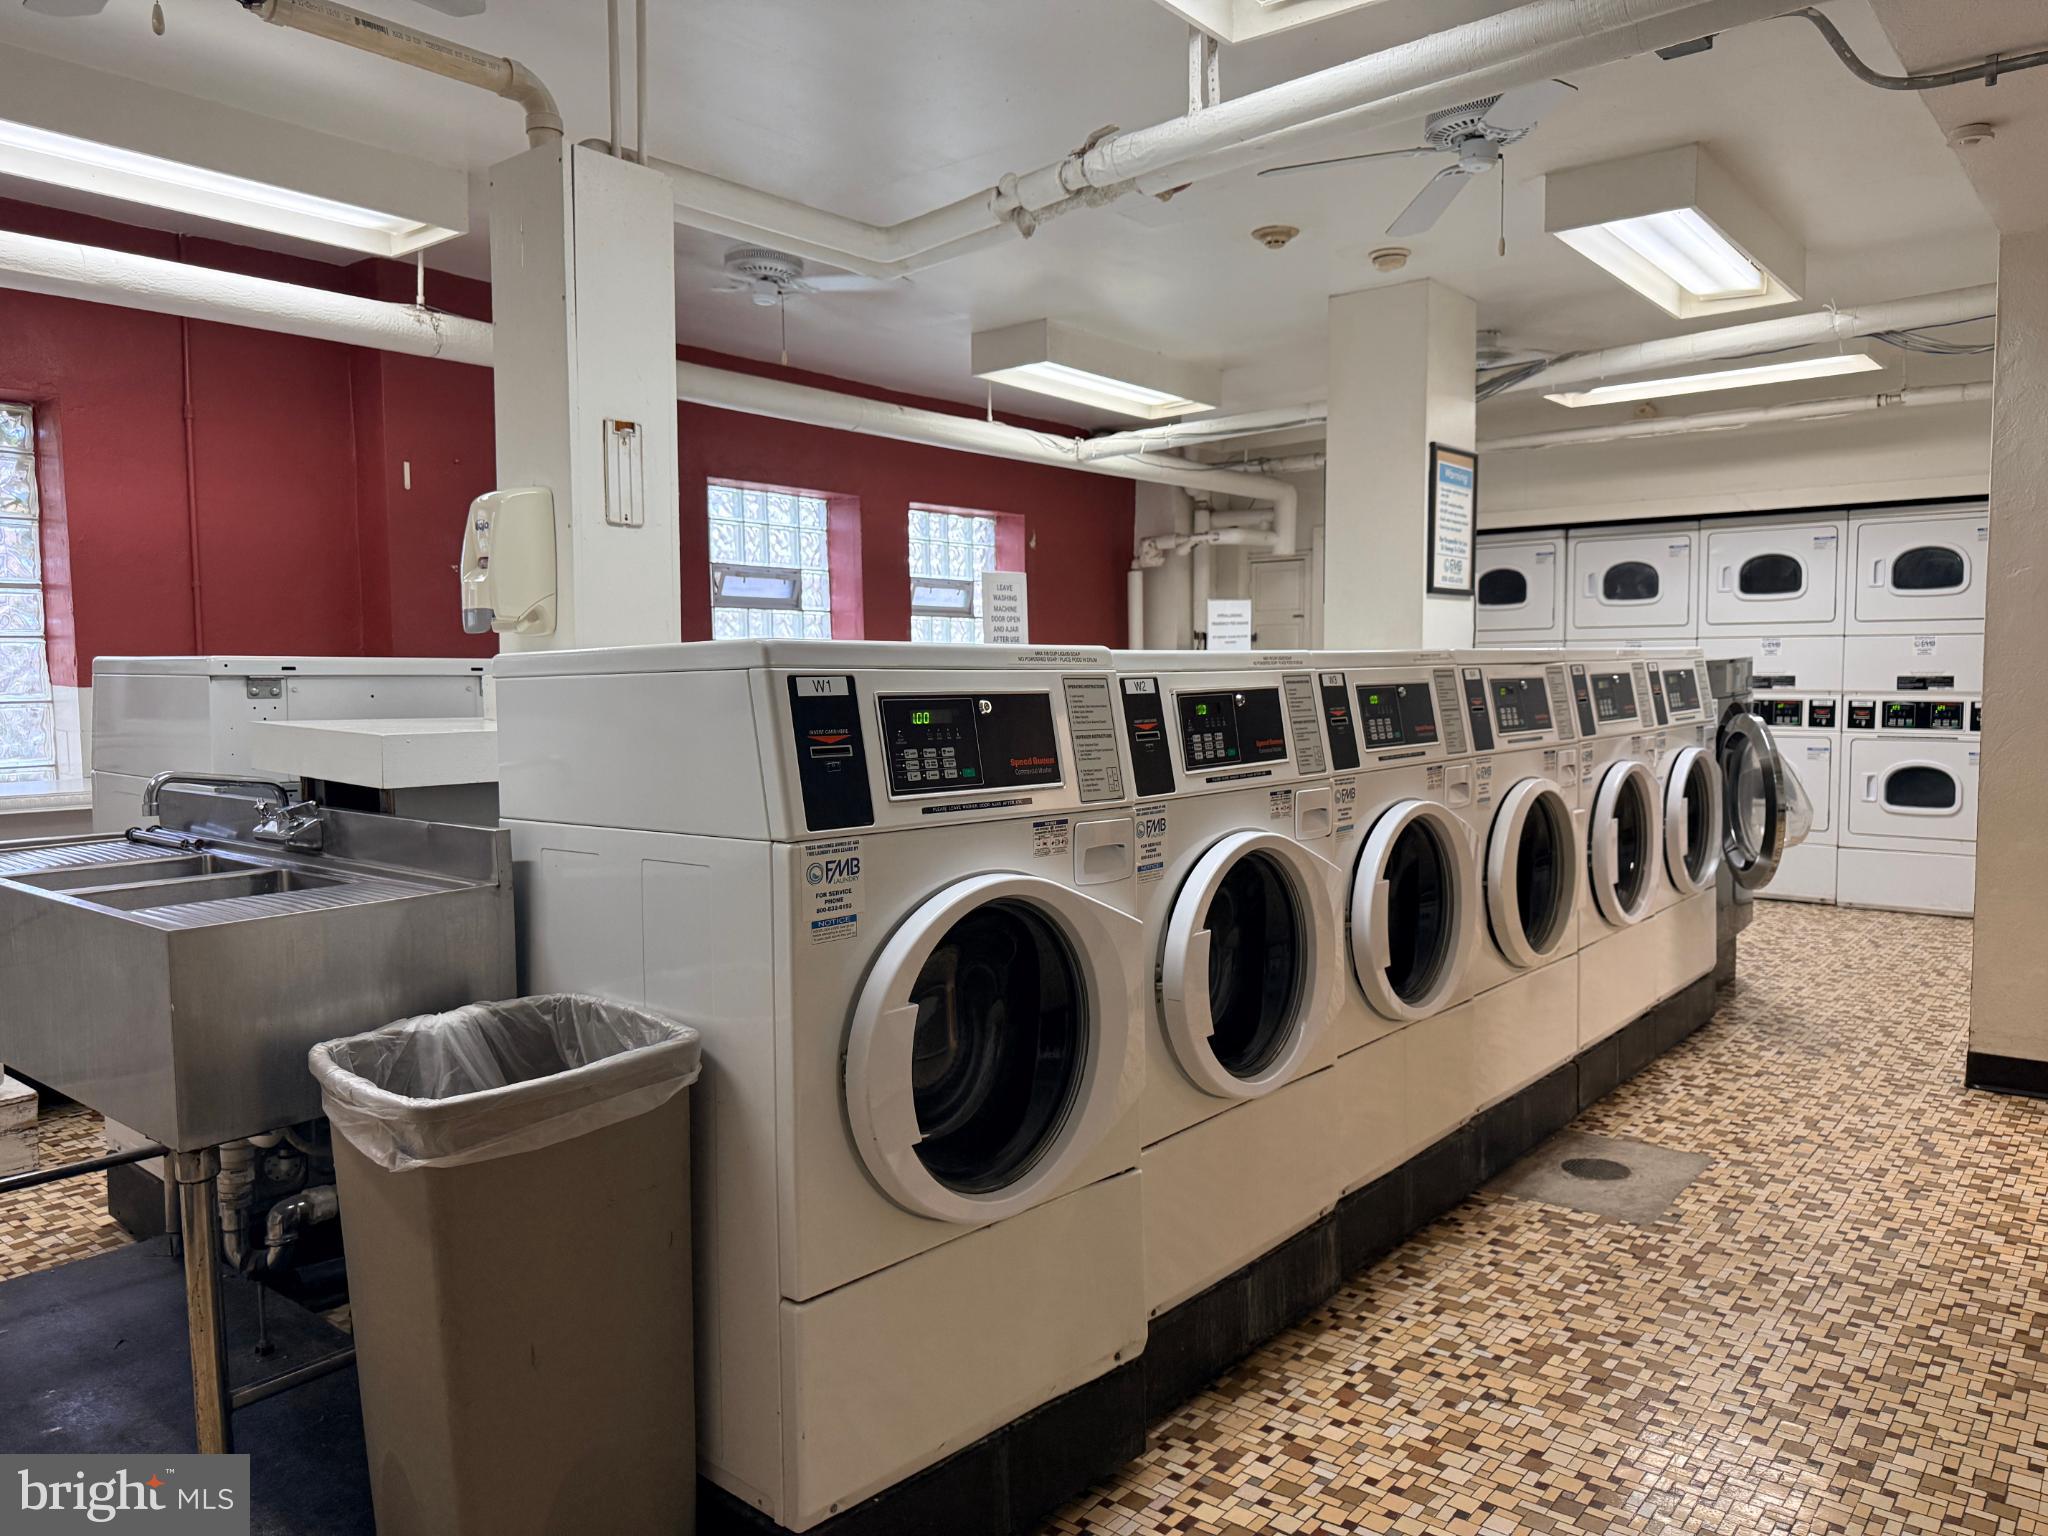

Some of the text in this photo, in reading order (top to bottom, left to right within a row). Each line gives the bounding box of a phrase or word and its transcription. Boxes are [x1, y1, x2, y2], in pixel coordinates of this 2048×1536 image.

[993, 594, 1017, 602] WASHING
[812, 679, 832, 692] W1
[1134, 680, 1147, 691] W2
[1010, 757, 1055, 767] Speed Queen
[1146, 818, 1167, 838] FMB
[825, 857, 860, 884] FMB
[833, 875, 859, 884] LAUNDRY
[828, 888, 852, 897] SERVICE
[824, 897, 844, 905] PHONE
[818, 916, 850, 928] NOTICE
